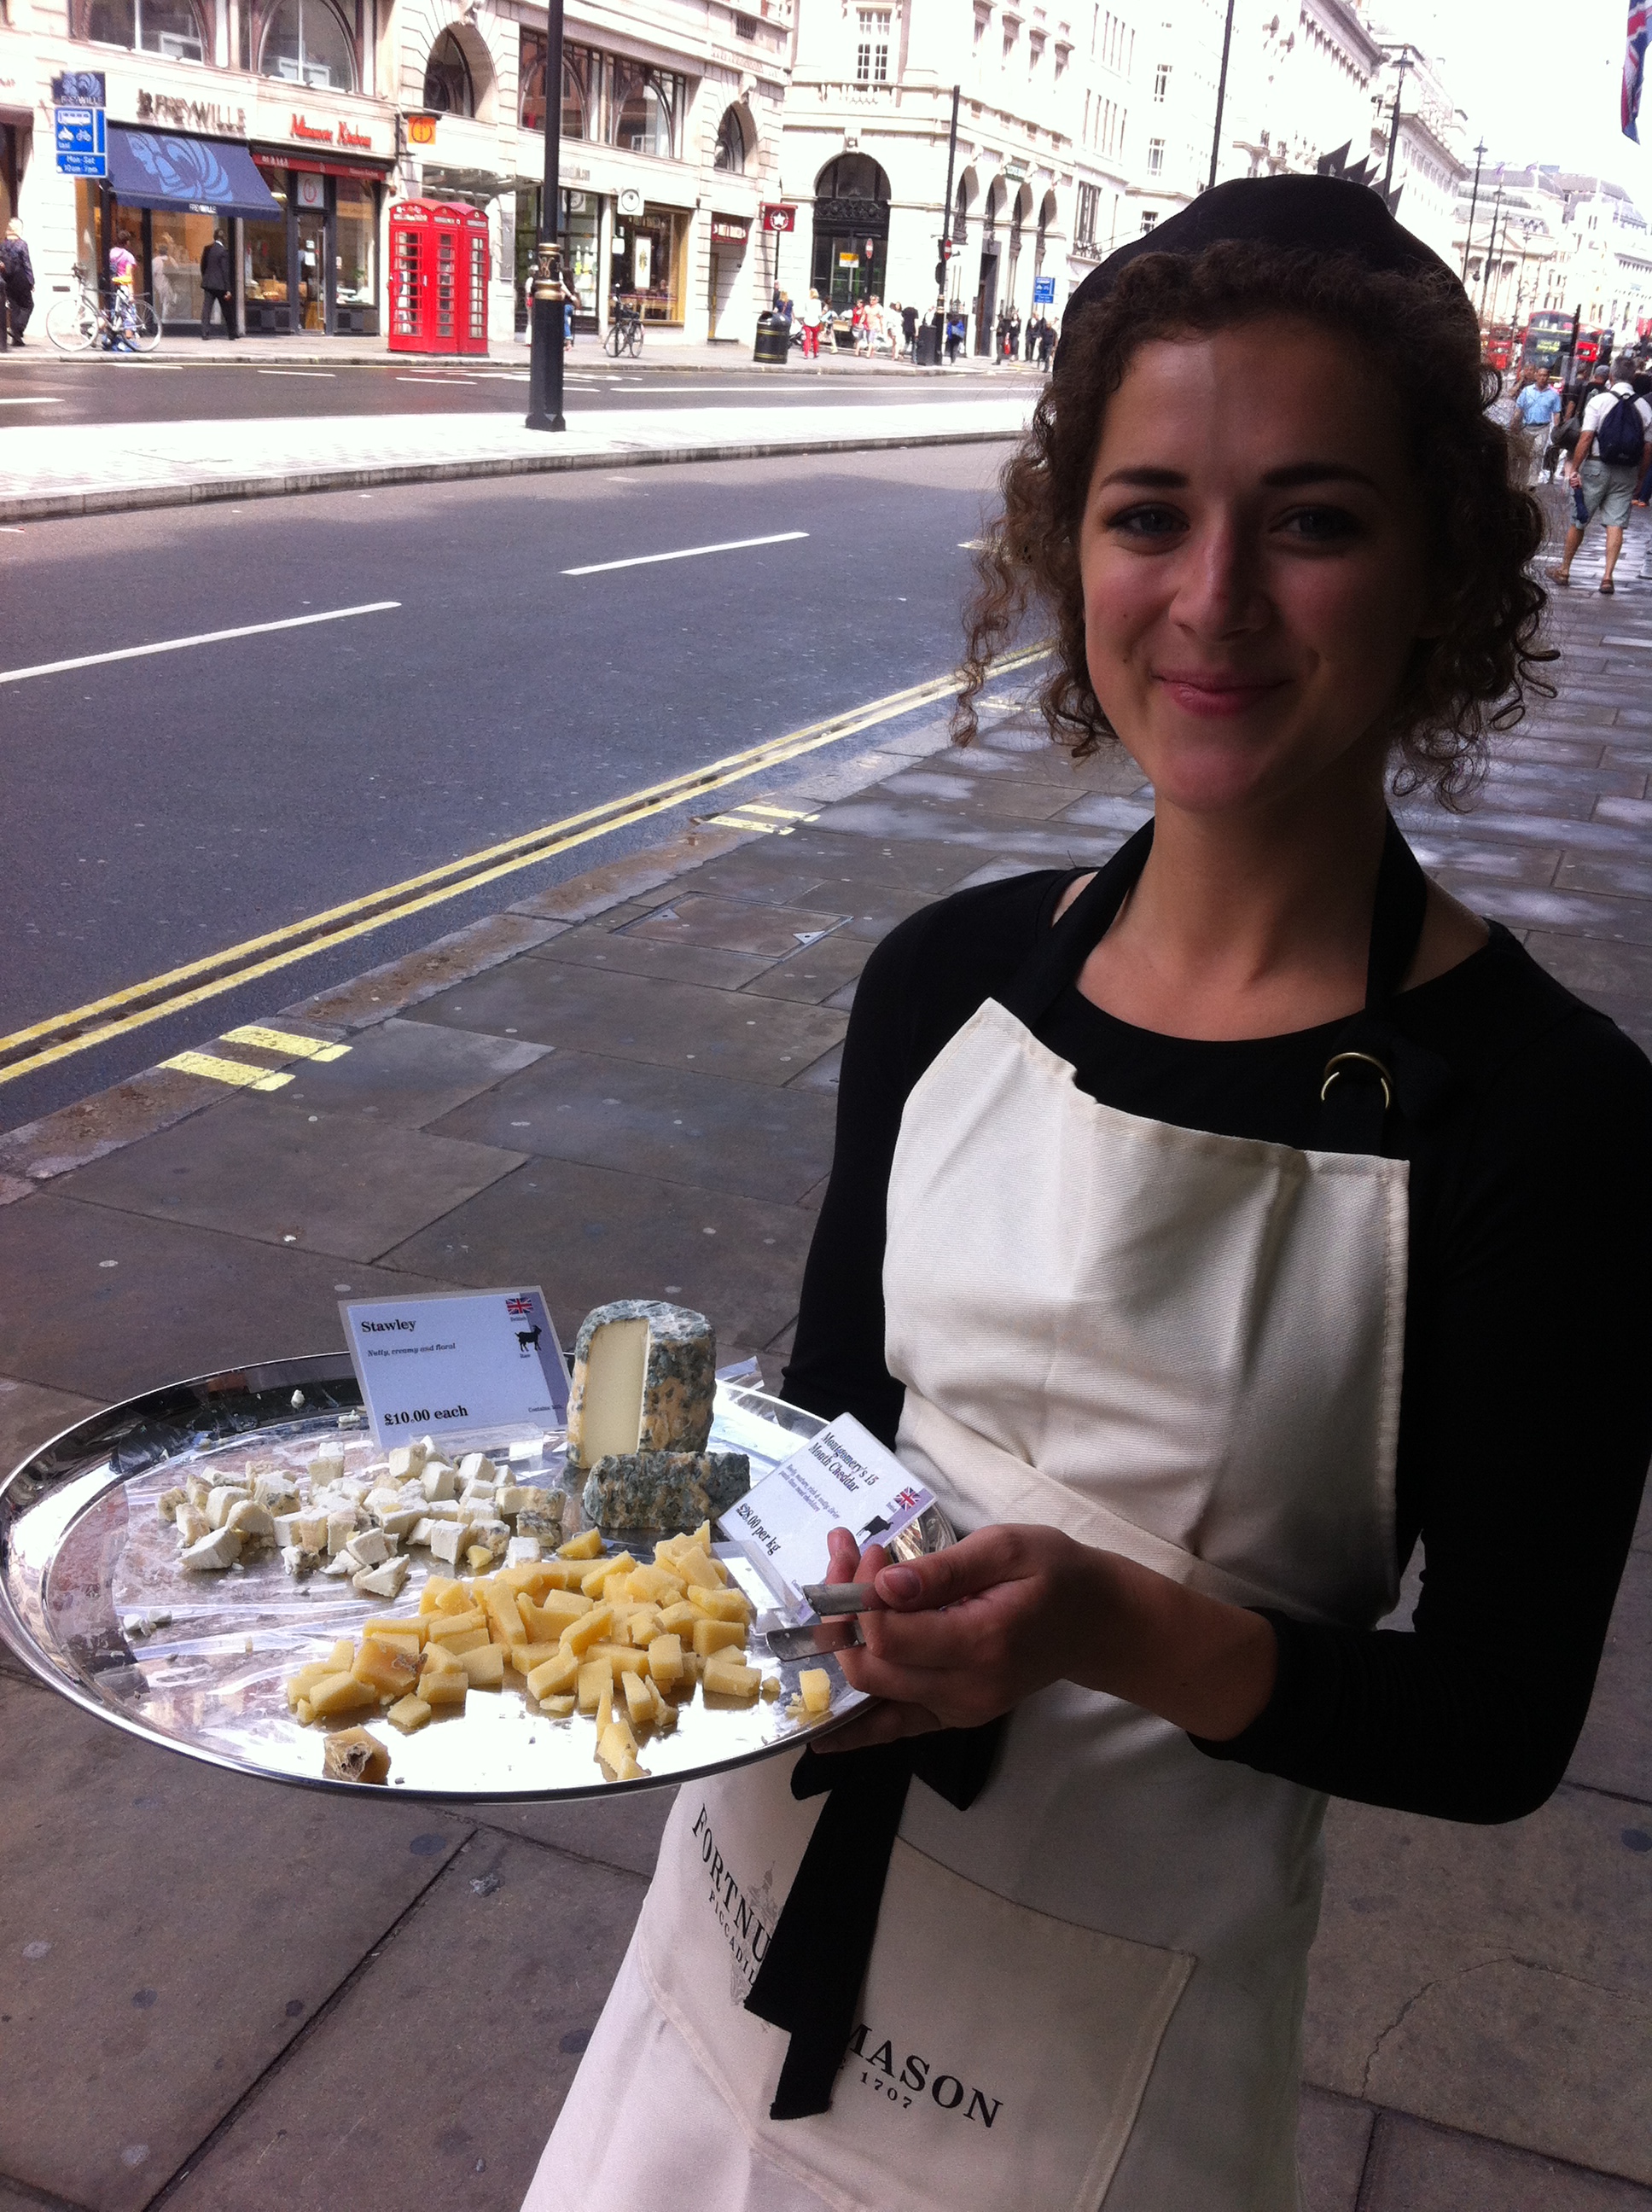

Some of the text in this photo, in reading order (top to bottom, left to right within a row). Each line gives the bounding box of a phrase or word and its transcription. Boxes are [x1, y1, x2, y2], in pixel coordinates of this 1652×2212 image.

[154, 93, 246, 131] FREYWILLE
[361, 1318, 416, 1333] Stawley
[435, 1342, 456, 1351] floral
[384, 1405, 468, 1426] £10.00 each
[807, 1441, 860, 1493] Month Cheddar
[821, 1431, 880, 1486] Montgomery's 15
[736, 1503, 782, 1557] £28.00 per kg
[692, 1802, 772, 1963] FORTNU
[708, 1888, 756, 1986] PICCADIL
[860, 2071, 913, 2109] 1707
